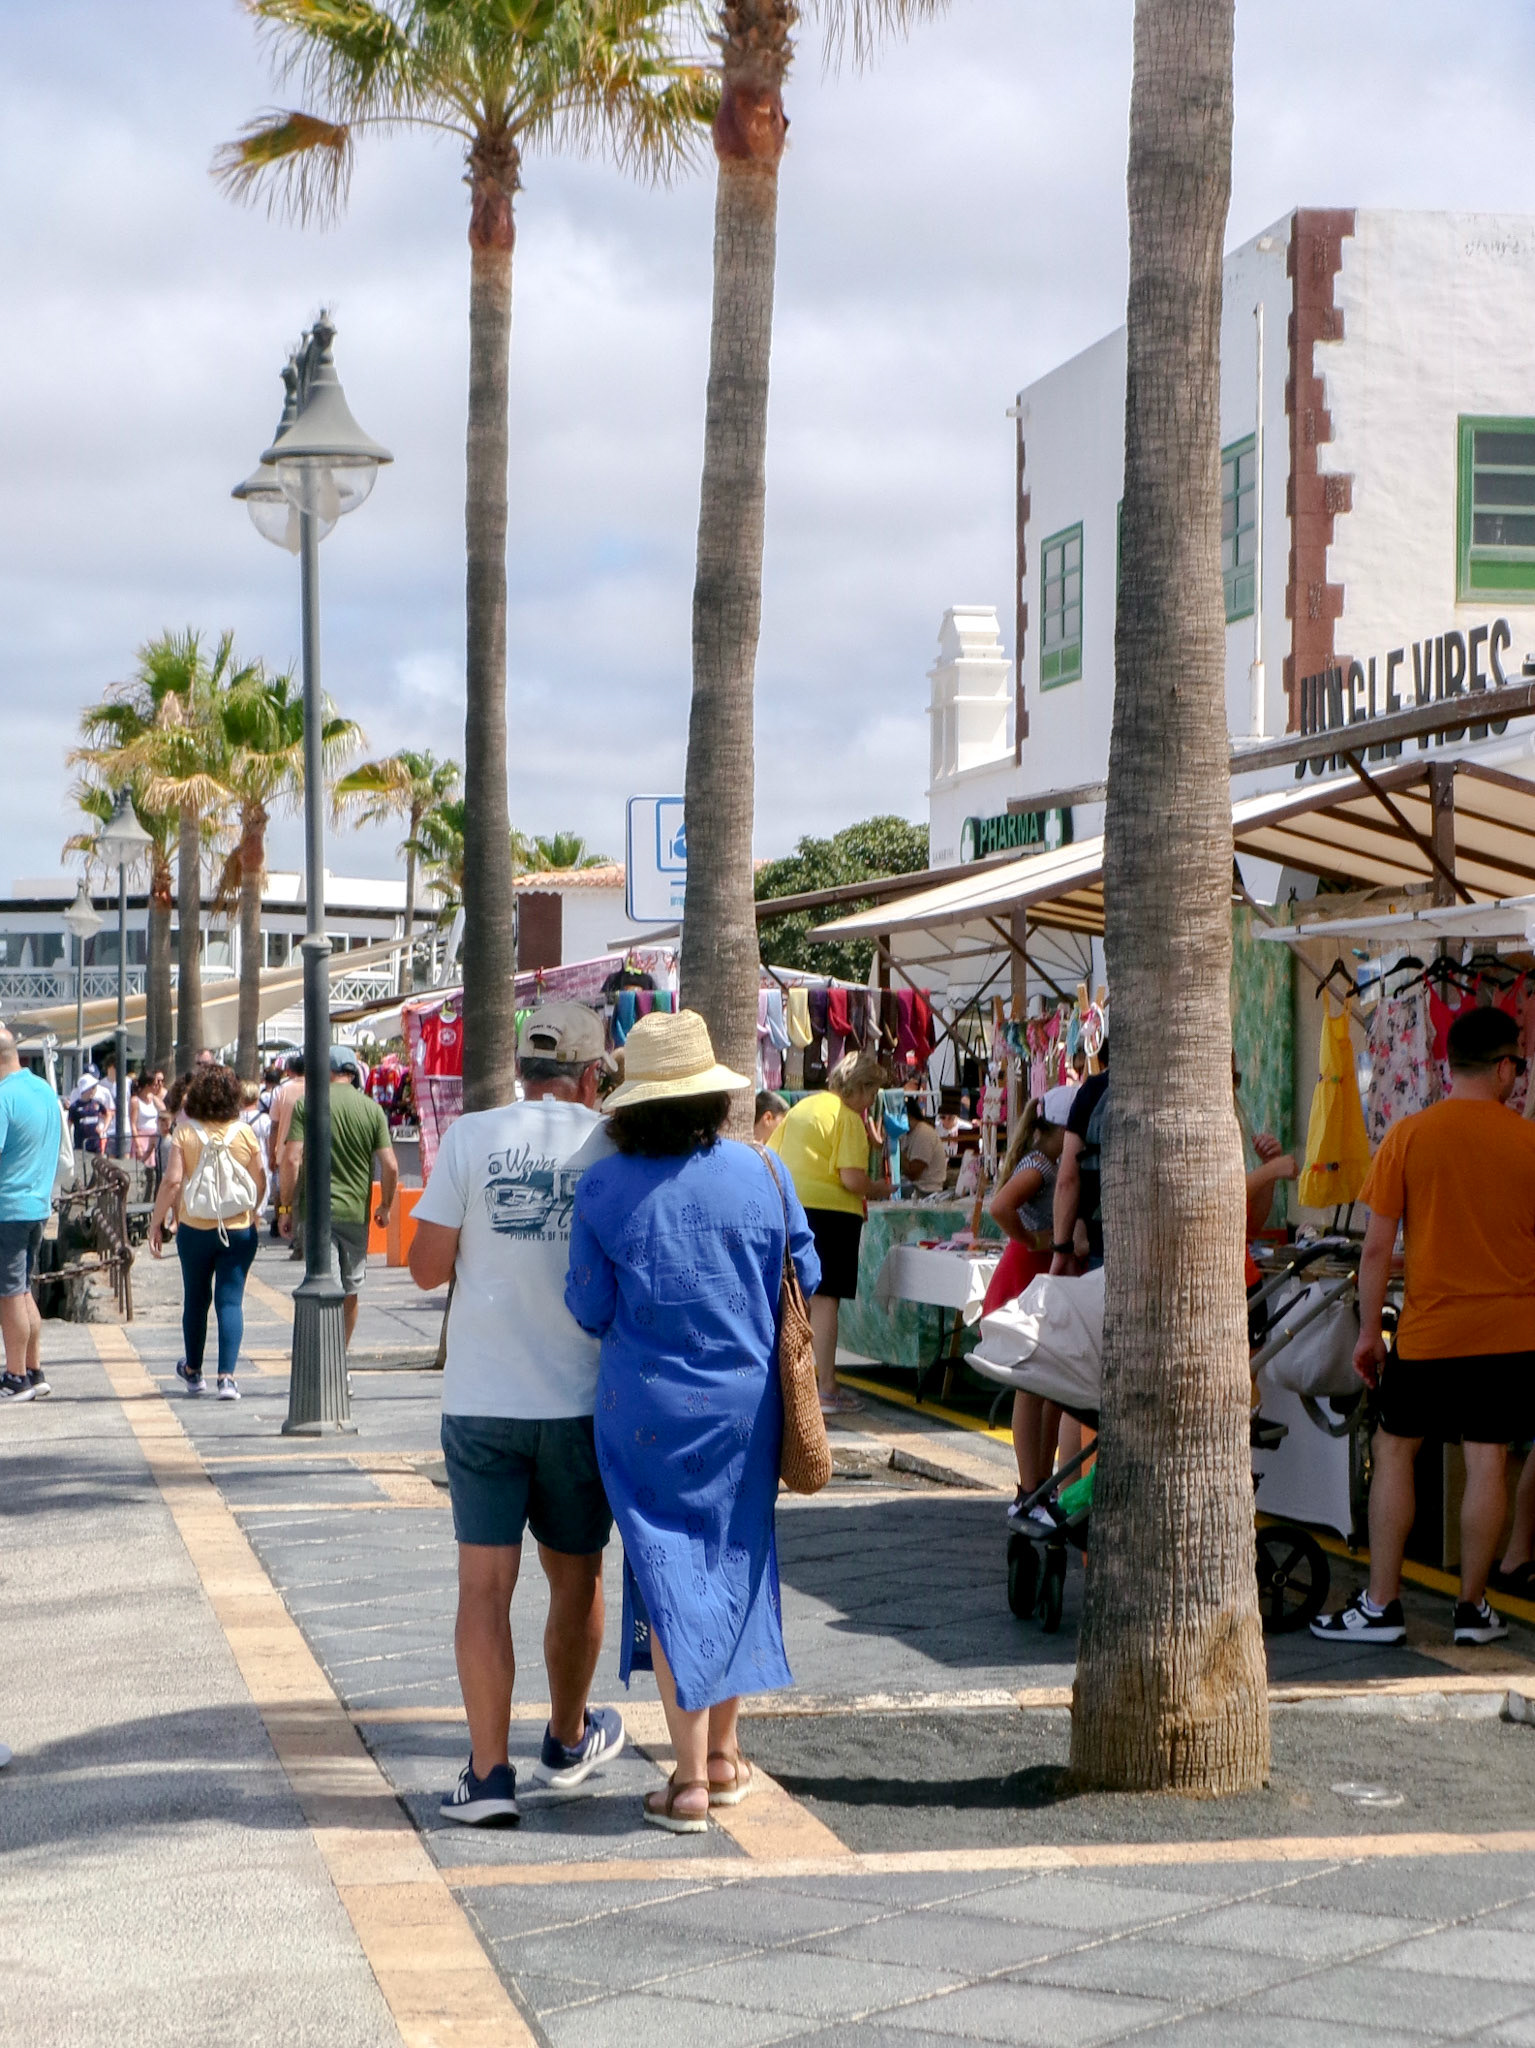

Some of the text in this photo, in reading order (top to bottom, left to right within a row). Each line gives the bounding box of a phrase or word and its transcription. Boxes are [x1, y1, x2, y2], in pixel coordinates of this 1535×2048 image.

[1412, 617, 1512, 750] VIBES
[980, 811, 1040, 856] PHARMA
[489, 1142, 558, 1180] Waves
[548, 1231, 556, 1241] OF
